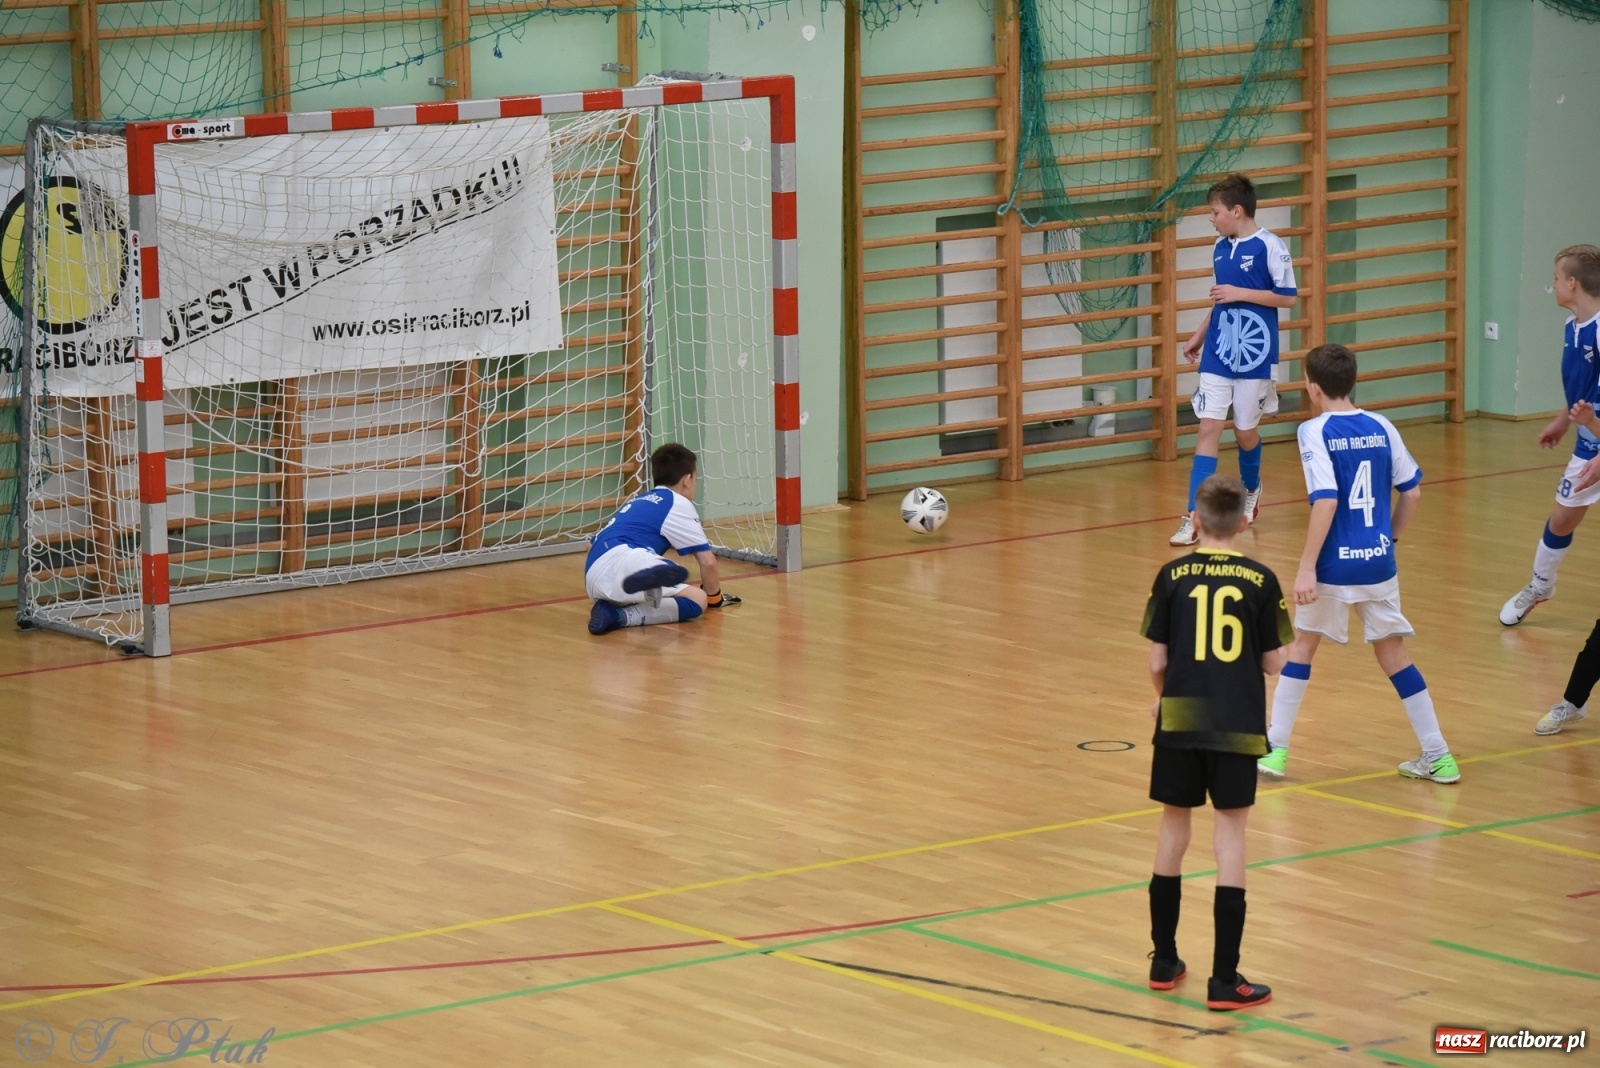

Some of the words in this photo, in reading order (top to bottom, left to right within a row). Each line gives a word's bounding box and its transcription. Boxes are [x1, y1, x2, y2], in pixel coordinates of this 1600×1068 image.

[203, 123, 231, 135] sport
[161, 275, 252, 347] JEST
[262, 254, 301, 298] W
[313, 300, 531, 341] www.osir-raciborz.pl
[1328, 437, 1349, 451] UNIA
[1348, 460, 1376, 527] 4
[1171, 564, 1190, 580] LKS
[1191, 563, 1205, 576] 07
[1205, 564, 1265, 588] MARKOWICE
[1188, 584, 1244, 662] 16
